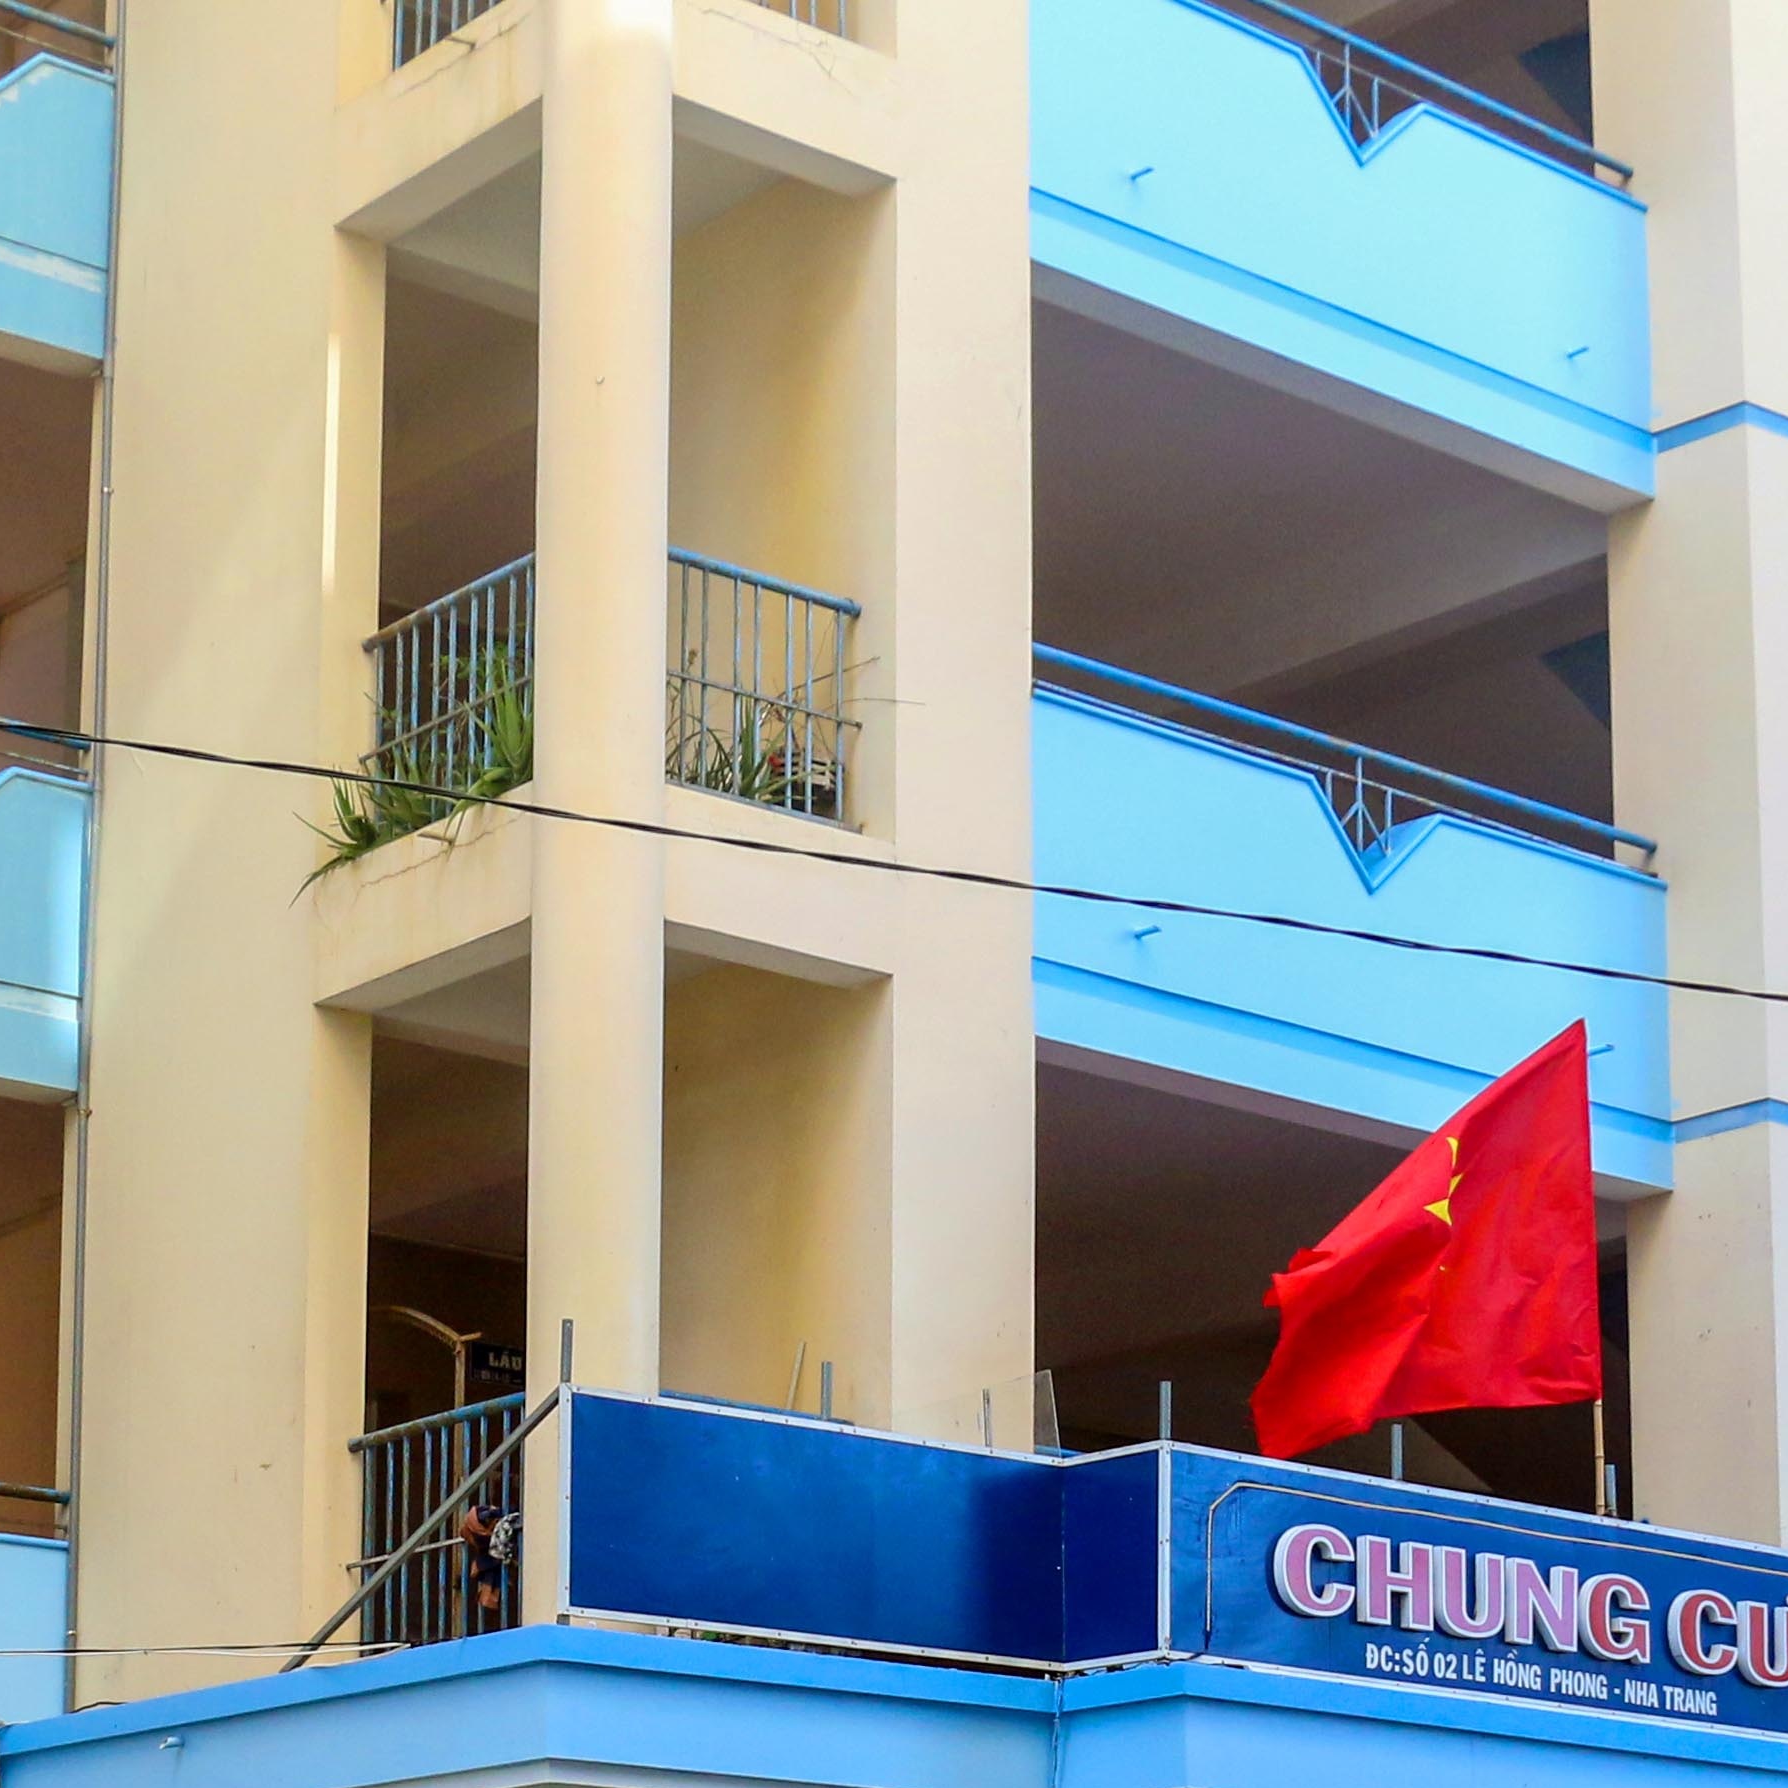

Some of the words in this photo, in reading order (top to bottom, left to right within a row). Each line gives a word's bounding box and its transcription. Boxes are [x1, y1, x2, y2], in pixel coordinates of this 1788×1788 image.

[1273, 1523, 1650, 1664] CHUNG
[1433, 1652, 1457, 1680] 02
[1462, 1648, 1487, 1683] LÊ
[1493, 1649, 1542, 1691] HỒNG
[1549, 1667, 1608, 1700] PHONG
[1624, 1678, 1659, 1709] NHA
[1662, 1685, 1718, 1716] TRANG
